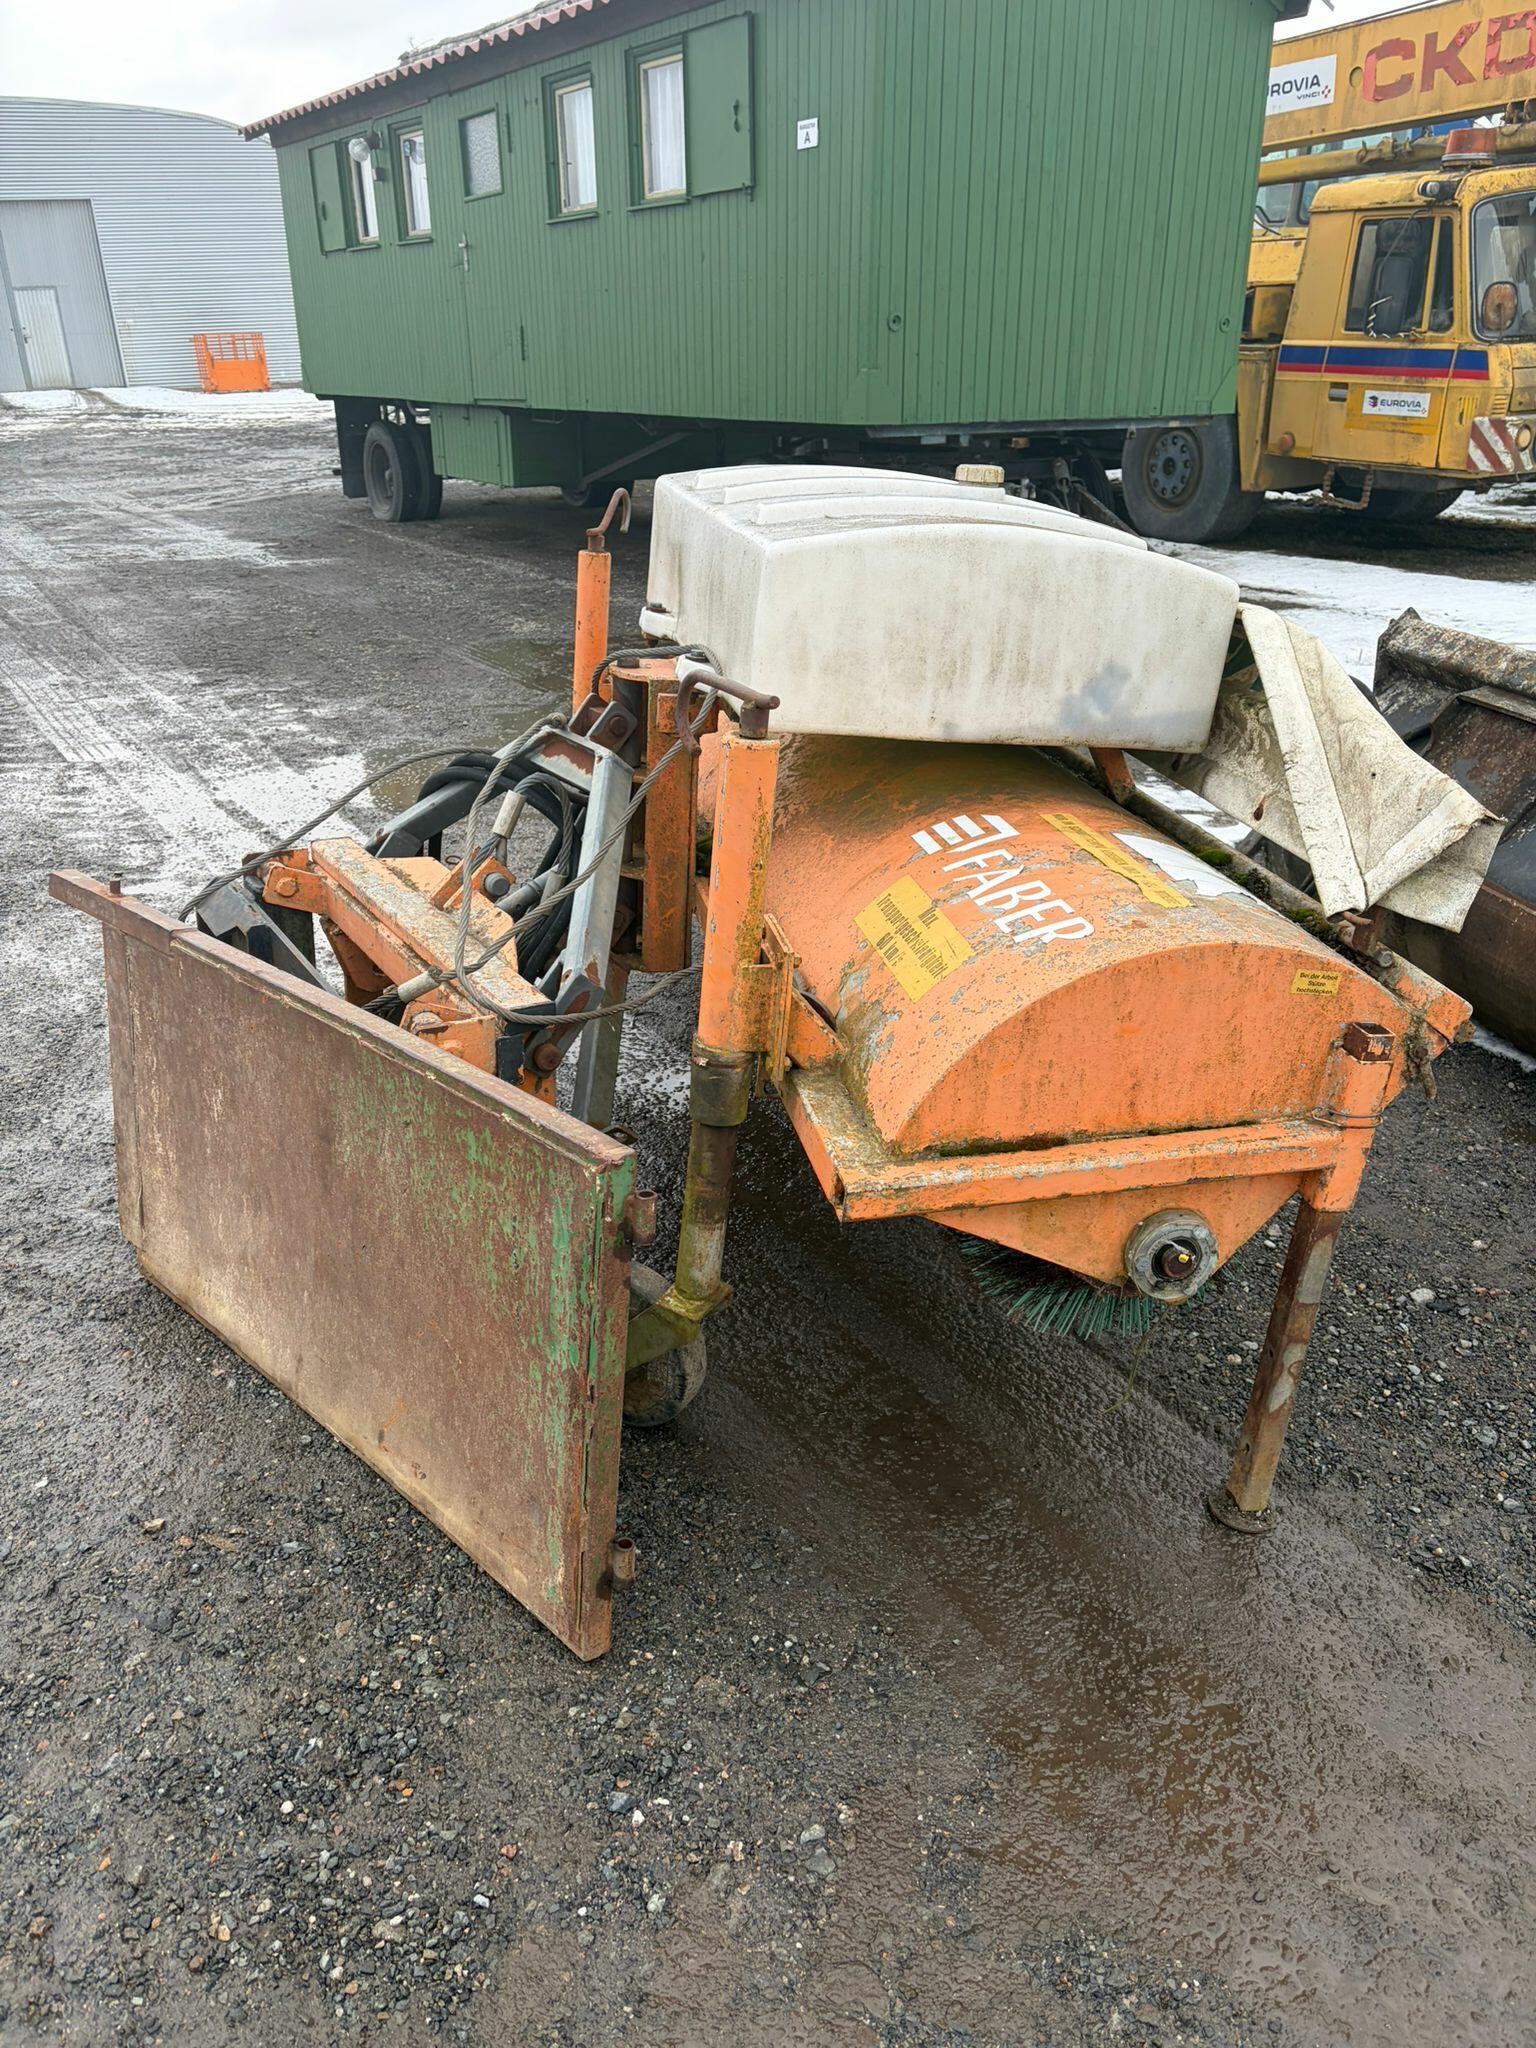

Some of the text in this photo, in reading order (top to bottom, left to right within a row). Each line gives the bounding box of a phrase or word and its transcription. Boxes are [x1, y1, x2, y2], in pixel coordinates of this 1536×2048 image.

[1297, 90, 1320, 100] VINCI
[804, 131, 811, 144] A
[1380, 399, 1421, 408] EUROVIA
[942, 848, 1095, 943] FABER
[918, 906, 939, 930] Max.
[876, 932, 894, 950] 60
